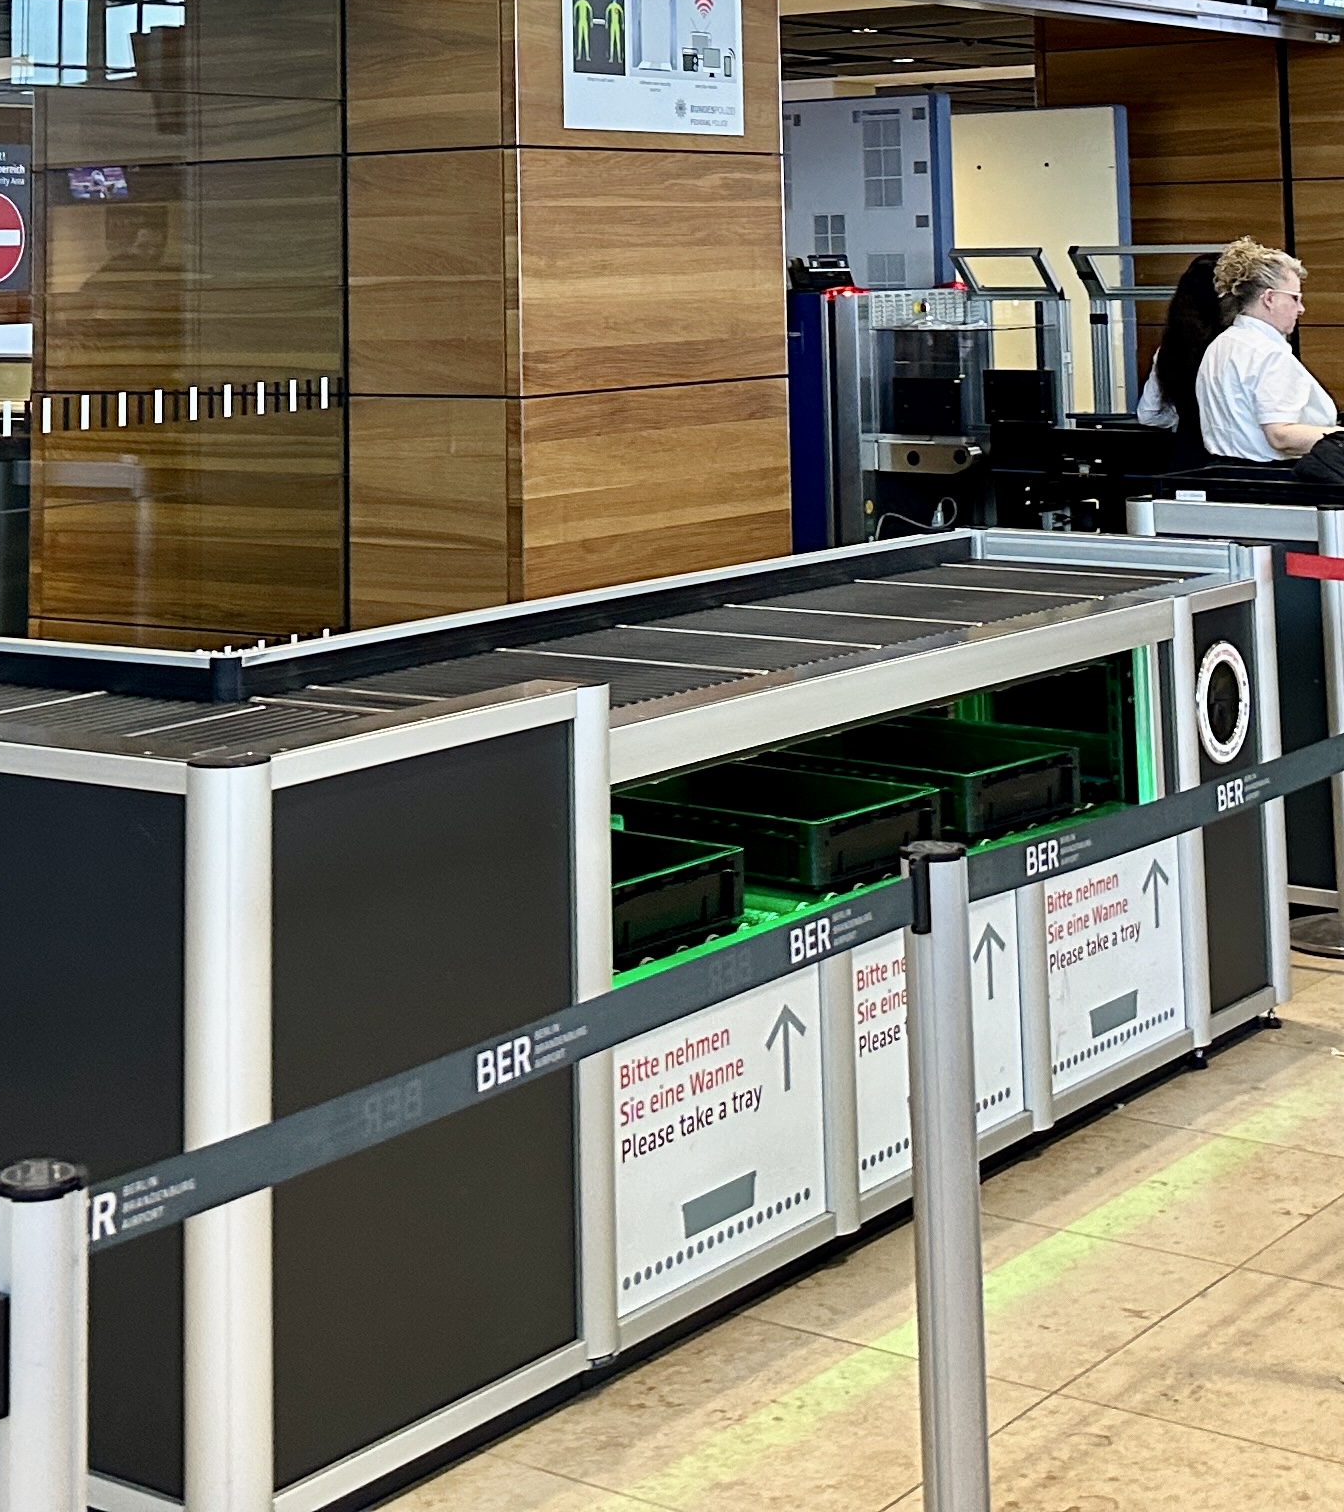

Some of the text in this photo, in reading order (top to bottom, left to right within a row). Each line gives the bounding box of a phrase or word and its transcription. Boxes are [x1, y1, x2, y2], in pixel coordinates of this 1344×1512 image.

[1217, 777, 1245, 812] BER
[1025, 839, 1060, 877] BER
[1046, 872, 1119, 915] Bitte nehmen
[789, 916, 832, 965] BER
[1047, 896, 1129, 945] Sie eine Wanne
[1048, 920, 1141, 975] Please take a tray
[856, 958, 888, 992] Bitte
[857, 987, 907, 1025] Sie eine
[475, 1035, 533, 1093] BER
[619, 1026, 731, 1090] Bitte nehmen
[858, 1023, 901, 1059] Please
[619, 1056, 745, 1128] Sie eine Wanne
[620, 1084, 763, 1164] Please take a tray
